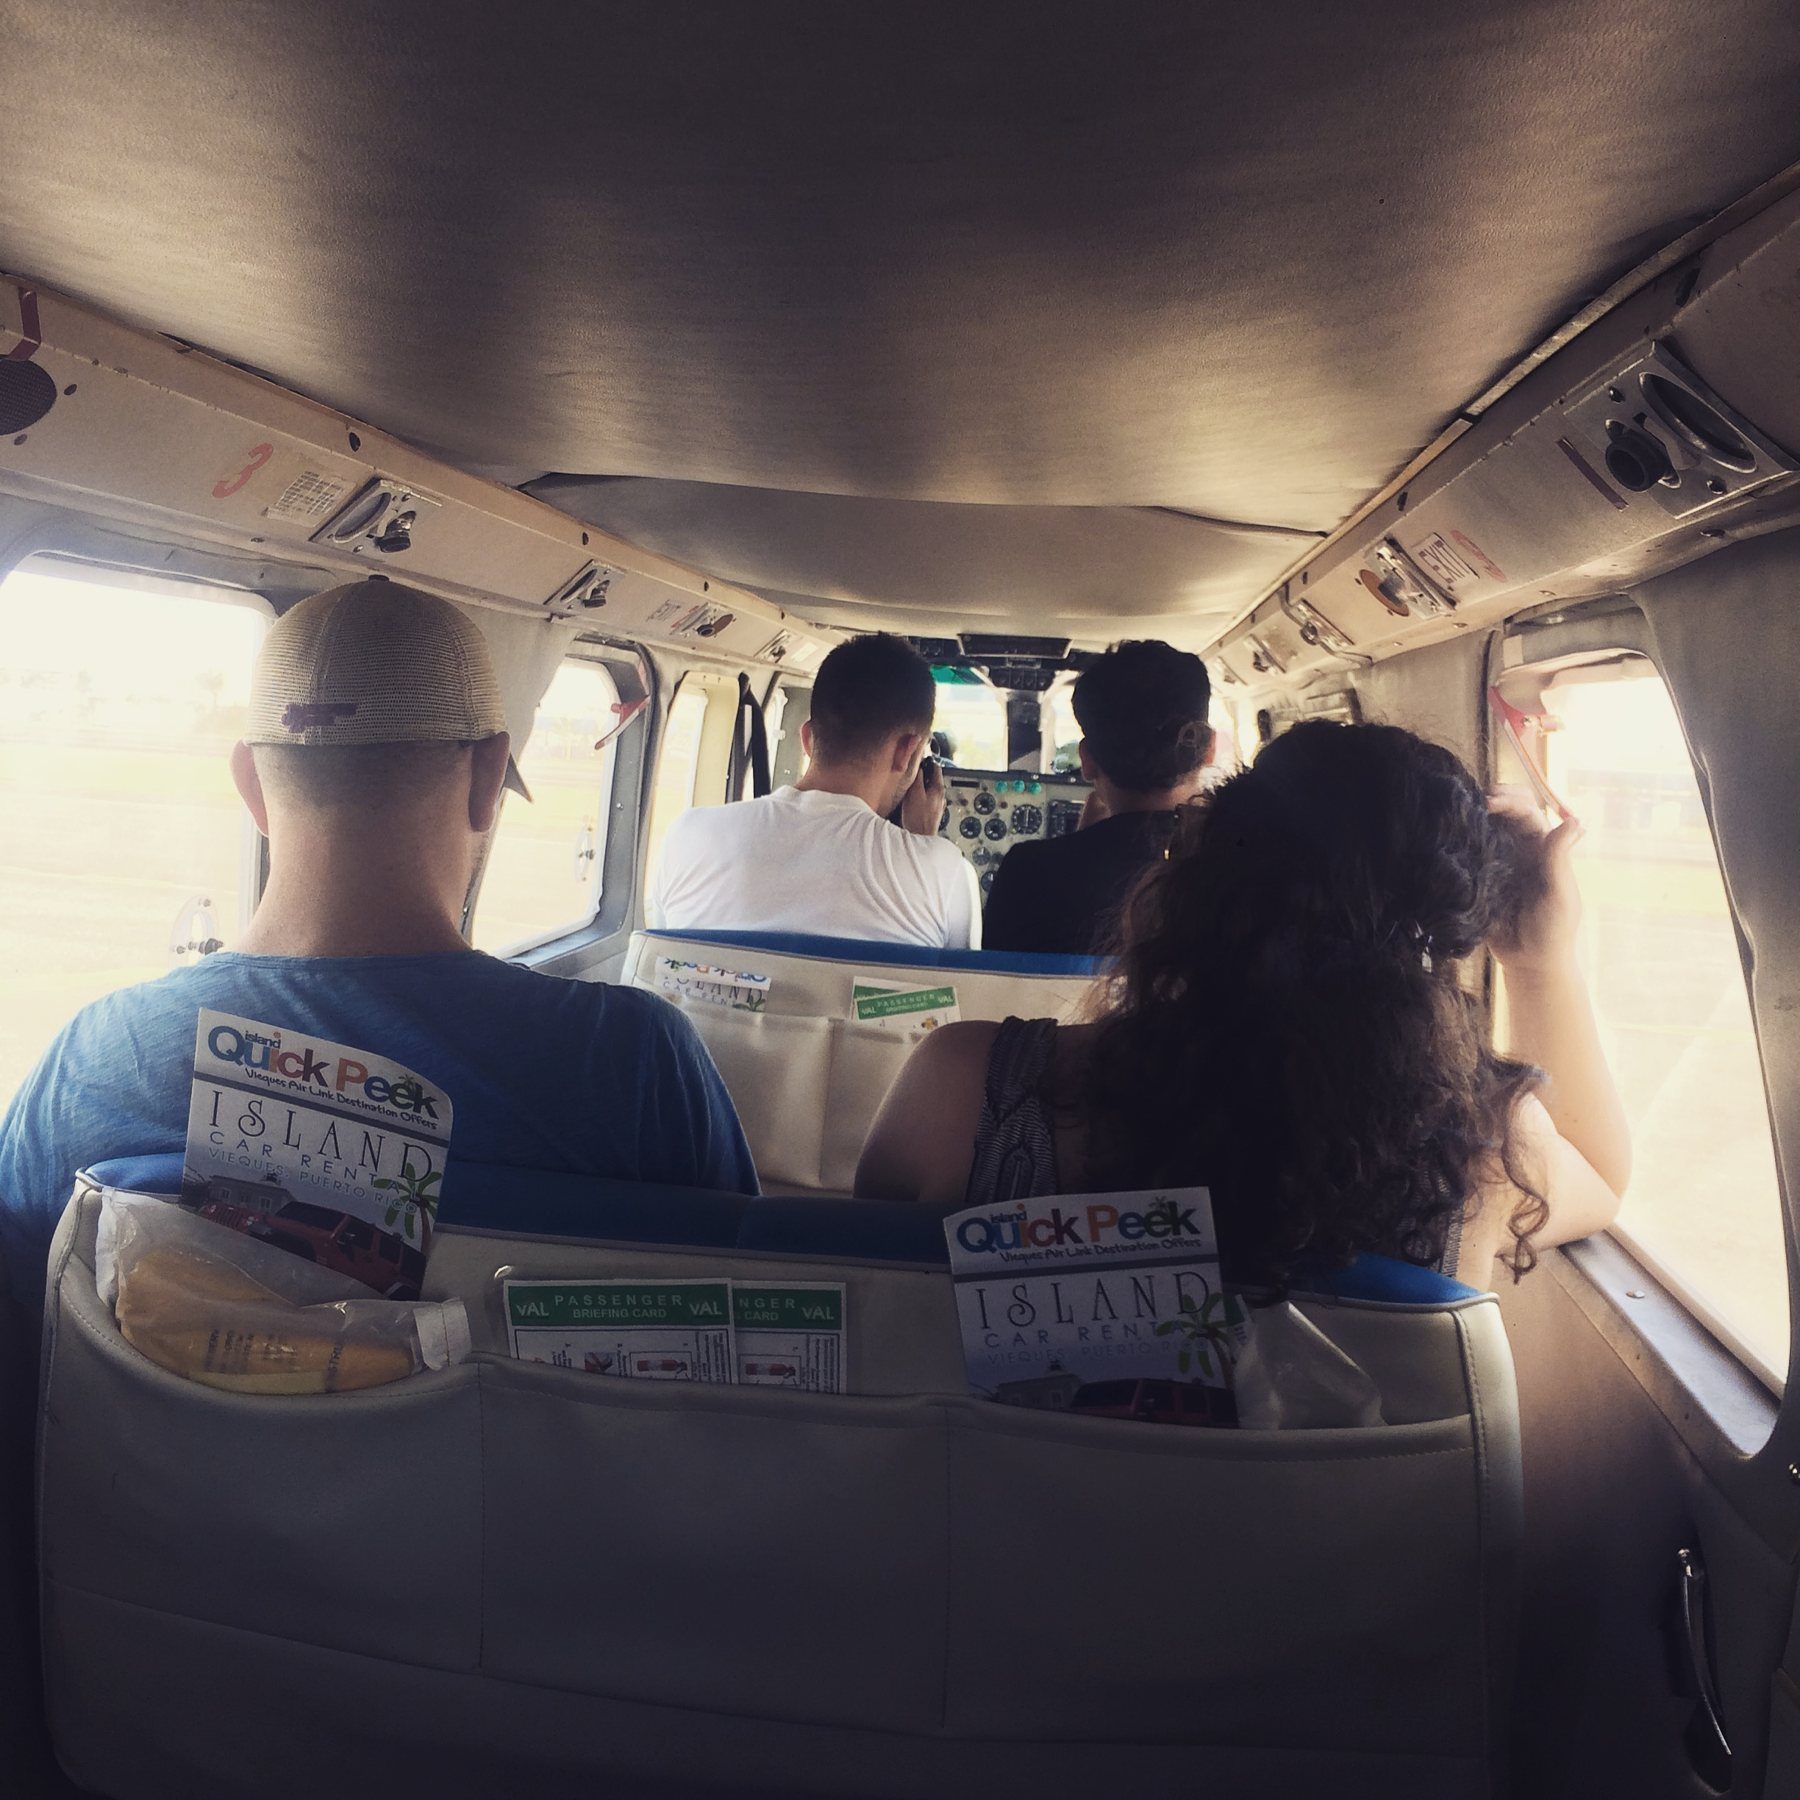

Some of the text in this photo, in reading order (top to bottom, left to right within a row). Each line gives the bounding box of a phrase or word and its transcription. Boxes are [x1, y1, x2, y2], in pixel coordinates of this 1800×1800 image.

[1418, 540, 1470, 584] EXIT
[245, 1030, 281, 1049] island
[208, 1026, 440, 1120] Quick Peek
[245, 1067, 438, 1131] Vieques Air Link Destination Offers
[208, 1090, 433, 1182] ISLAND
[209, 1131, 274, 1158] CAR
[300, 1171, 367, 1199] PUERTO
[956, 1200, 1201, 1254] Quick Peek
[1160, 1236, 1203, 1250] Offers
[516, 1294, 723, 1317] VAL PASSENGER VAL
[572, 1308, 668, 1319] BRIEFING CARD
[802, 1305, 836, 1320] VAL
[975, 1271, 1210, 1330] ISLAND
[744, 1311, 780, 1321] CARD
[984, 1329, 1049, 1349] CAR
